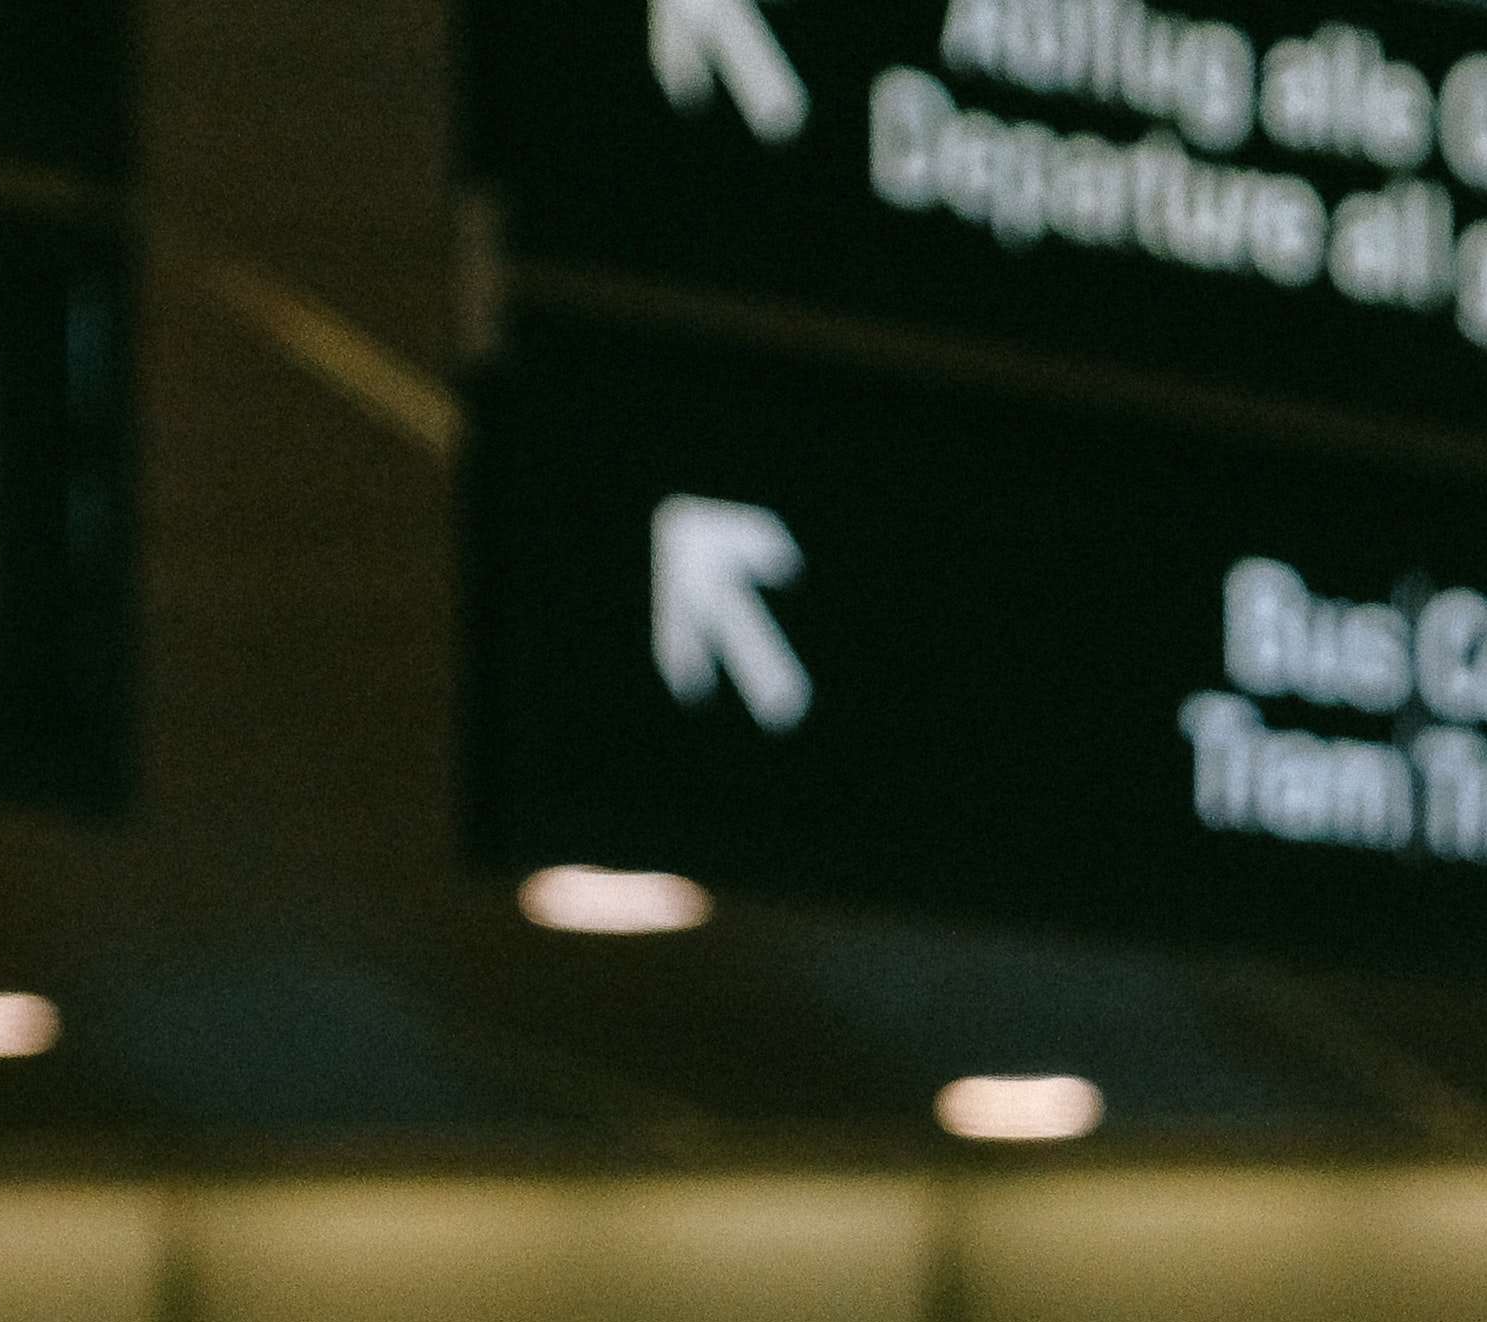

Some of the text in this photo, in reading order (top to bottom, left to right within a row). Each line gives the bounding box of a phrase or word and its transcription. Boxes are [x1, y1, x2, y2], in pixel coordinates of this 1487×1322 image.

[1261, 28, 1434, 164] alle
[872, 70, 1326, 284] Departure
[1329, 180, 1454, 306] all
[1226, 560, 1414, 710] Bus
[1183, 694, 1414, 848] Tram
